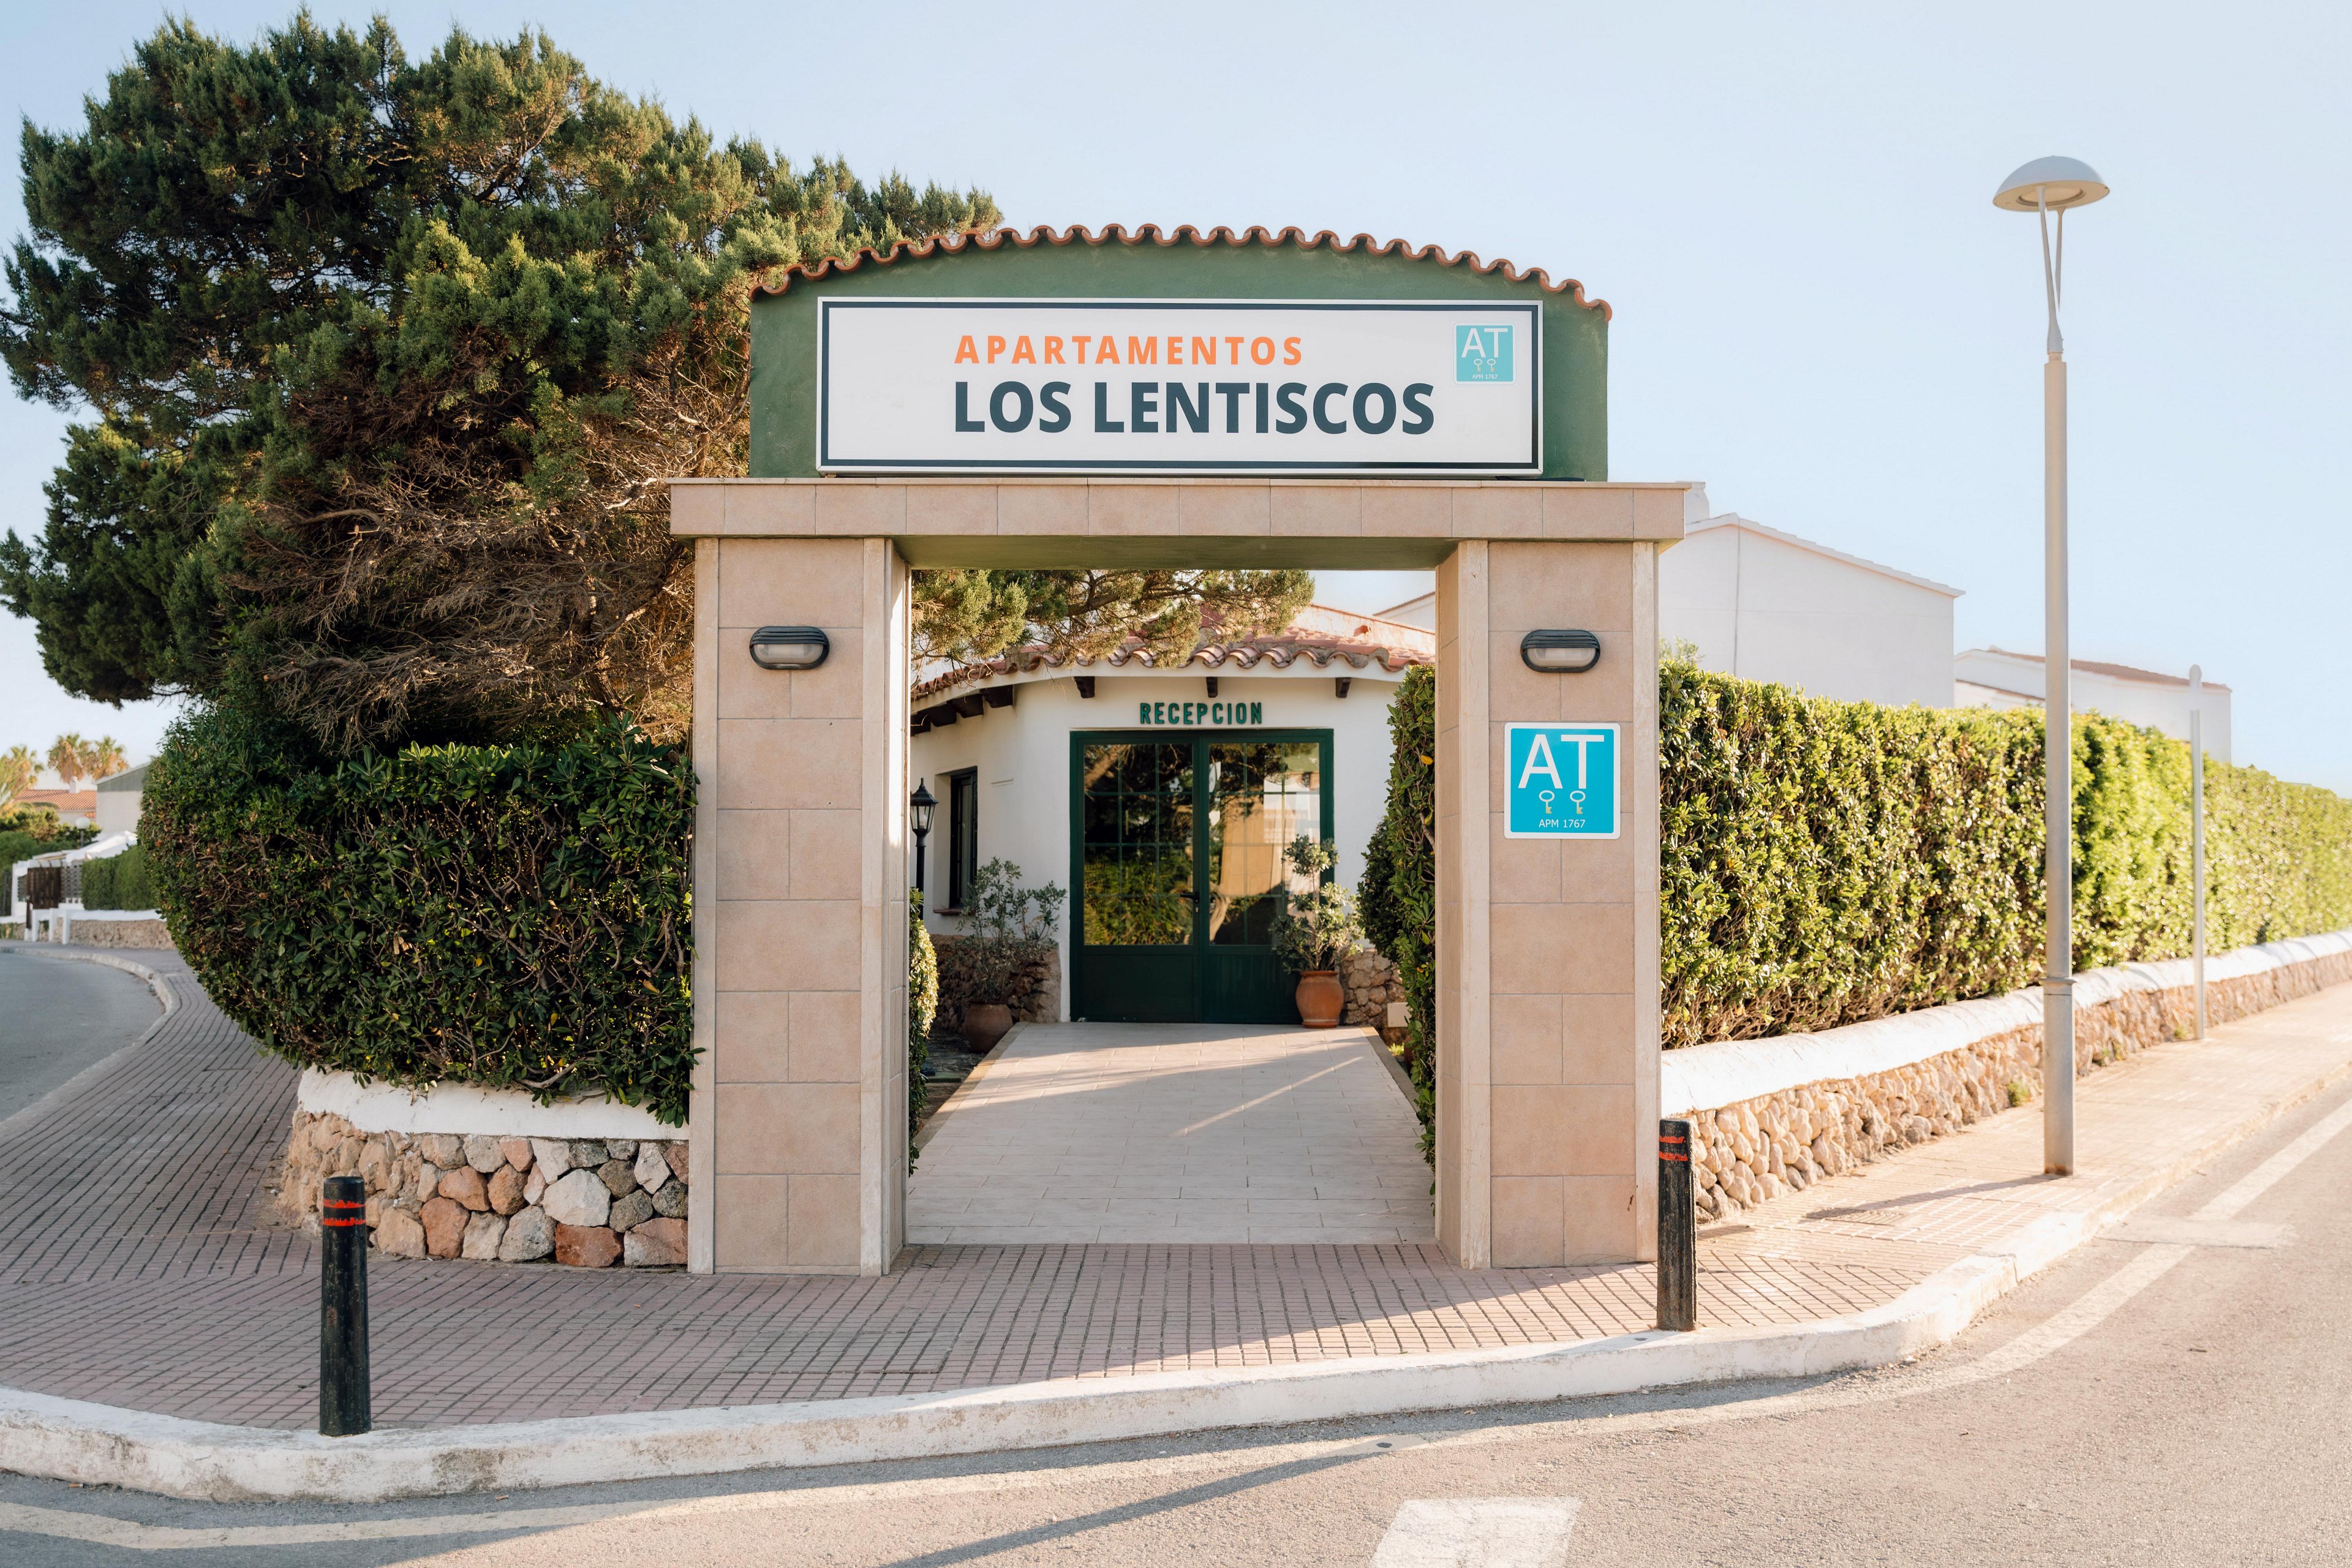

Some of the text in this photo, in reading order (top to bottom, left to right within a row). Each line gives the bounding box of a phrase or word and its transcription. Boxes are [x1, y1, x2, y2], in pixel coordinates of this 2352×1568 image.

[954, 334, 1302, 366] APARTAMENTOS
[1461, 328, 1509, 358] AT
[955, 381, 1434, 435] LOS LENTISCOS
[1140, 702, 1262, 725] RECEPCION
[1518, 734, 1605, 790] AT
[1539, 819, 1586, 828] APM 1767
